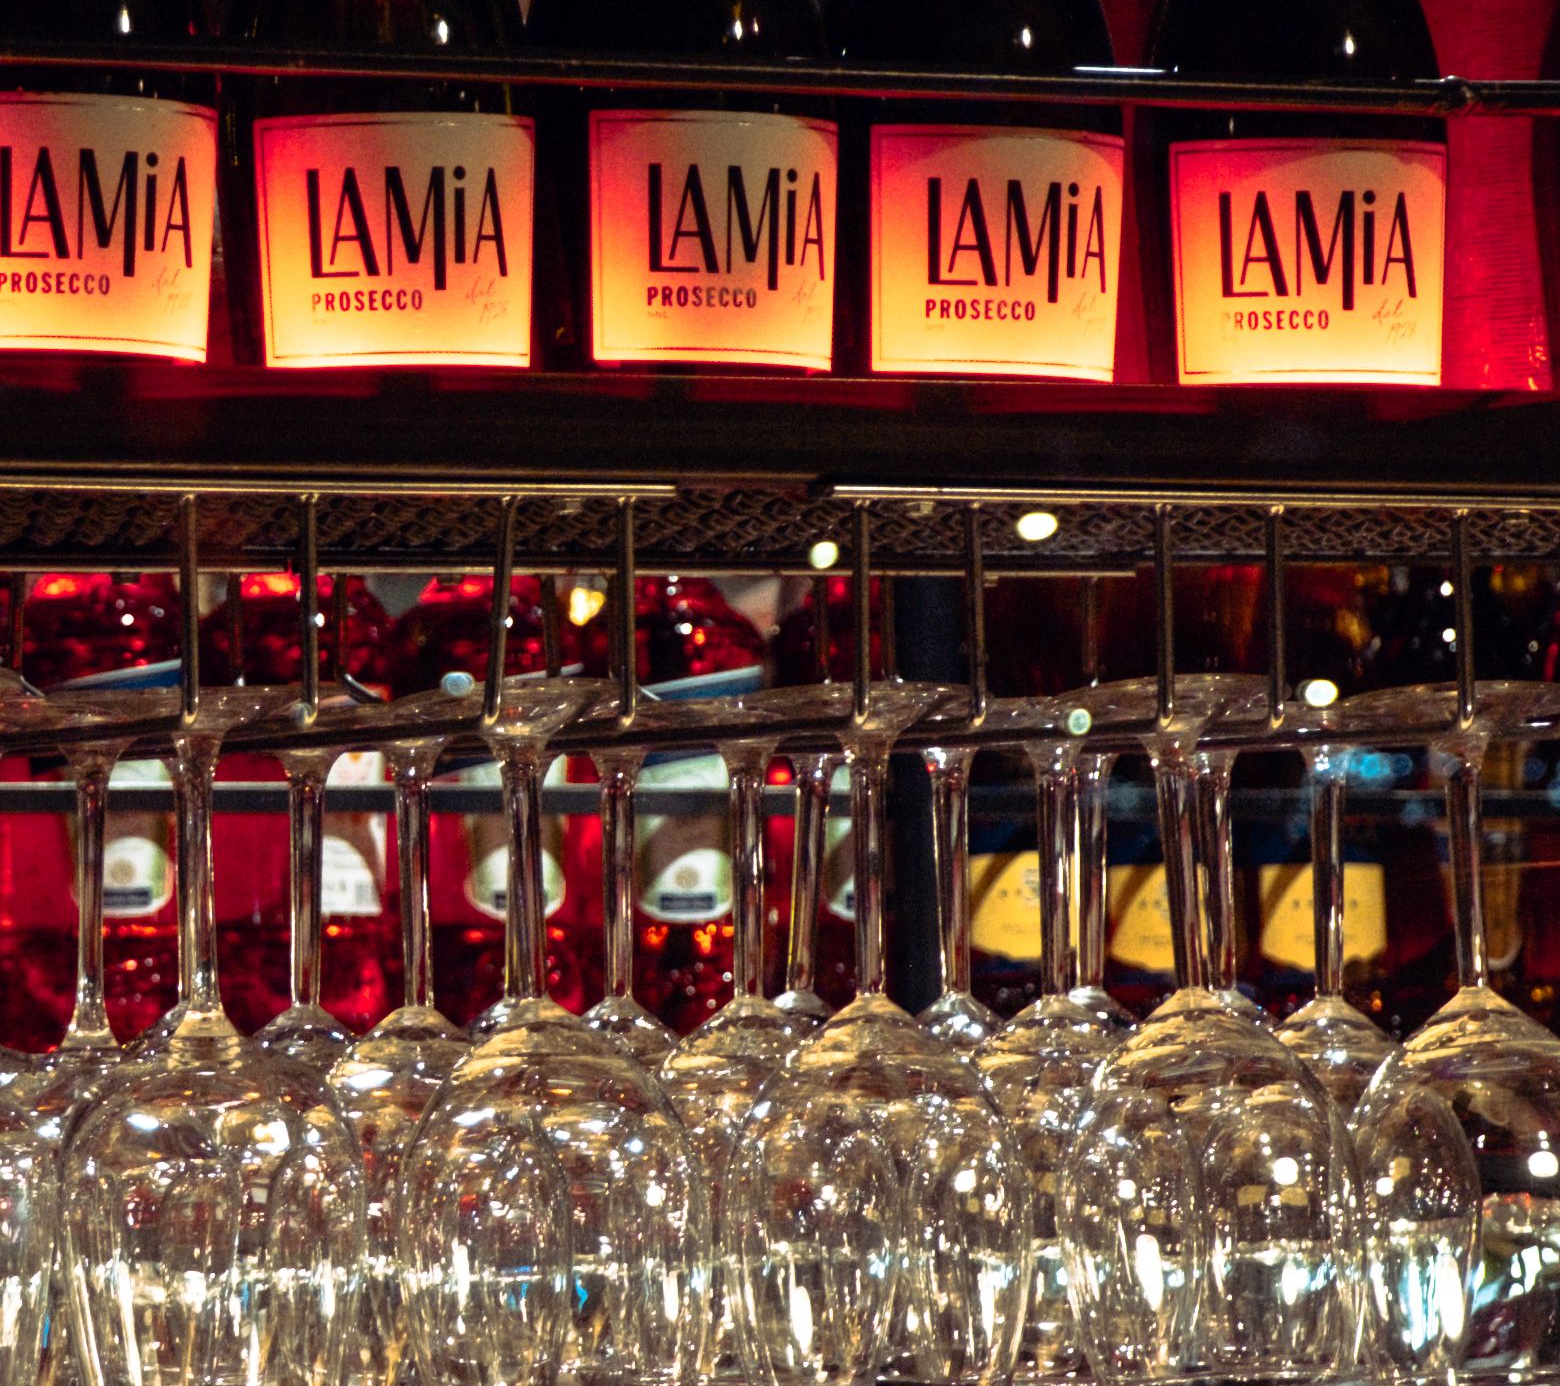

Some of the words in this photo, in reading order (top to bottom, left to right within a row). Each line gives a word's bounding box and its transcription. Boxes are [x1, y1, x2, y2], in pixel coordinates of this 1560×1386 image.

[310, 288, 425, 314] PROSECCO
[646, 285, 758, 310] PROSECCO
[925, 298, 1037, 322] PROSECCO
[1221, 309, 1330, 332] PROSECCO
